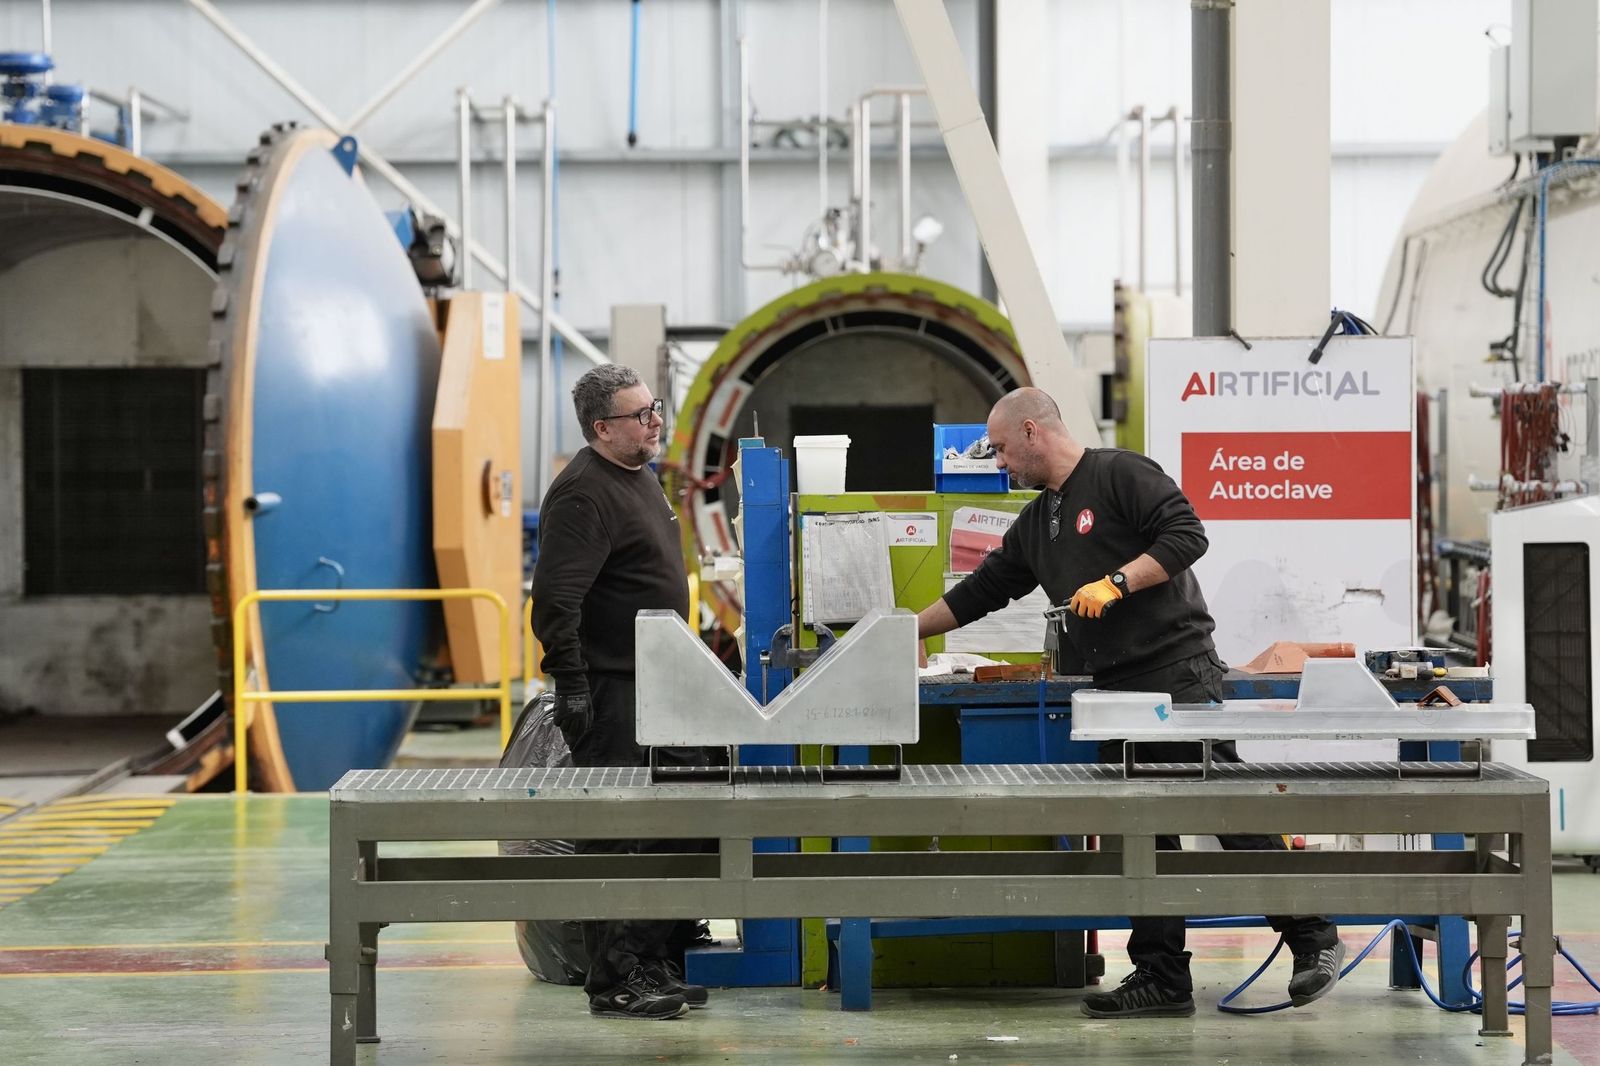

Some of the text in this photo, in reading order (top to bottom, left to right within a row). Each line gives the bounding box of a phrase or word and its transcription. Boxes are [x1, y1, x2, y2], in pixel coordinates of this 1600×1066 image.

[1181, 370, 1380, 401] AIRTIFICIAL
[1209, 448, 1305, 471] Área de
[1209, 480, 1333, 500] Autoclave
[967, 513, 1015, 528] AIRTIFIC
